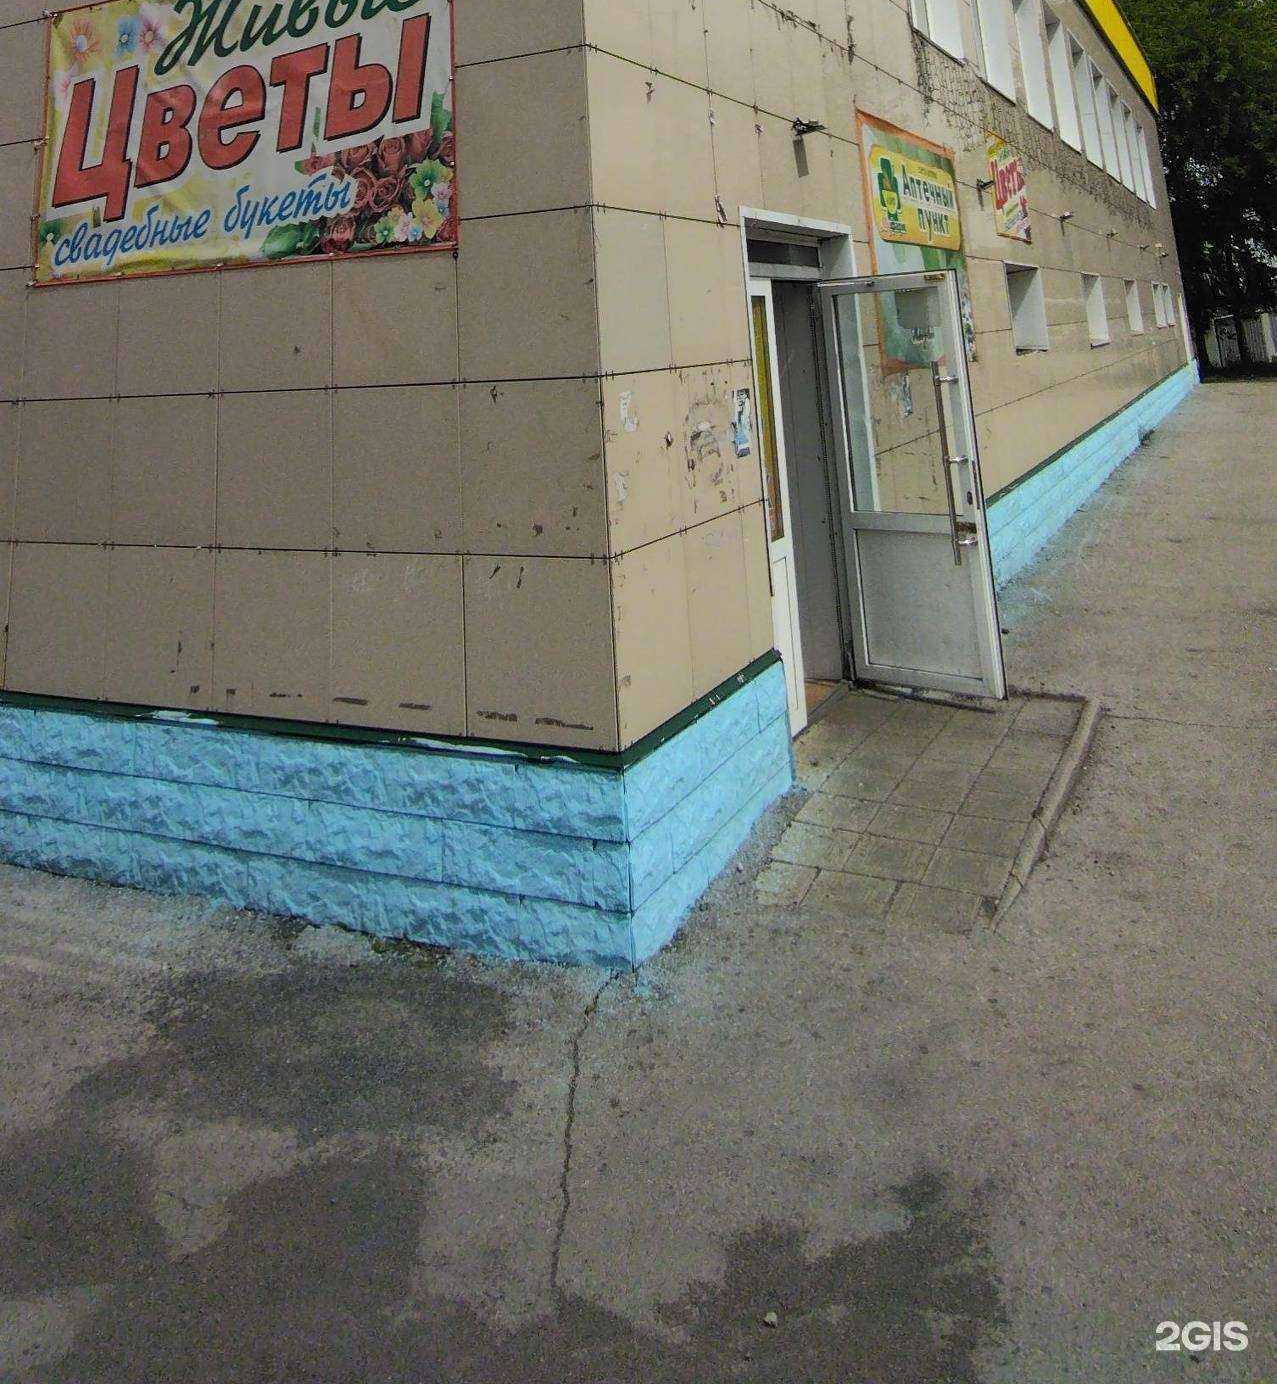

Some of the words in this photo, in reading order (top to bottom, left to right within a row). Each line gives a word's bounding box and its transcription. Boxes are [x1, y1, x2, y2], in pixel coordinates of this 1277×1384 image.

[52, 13, 431, 222] Цветы
[54, 204, 211, 267] свадебные
[223, 172, 351, 240] букеты
